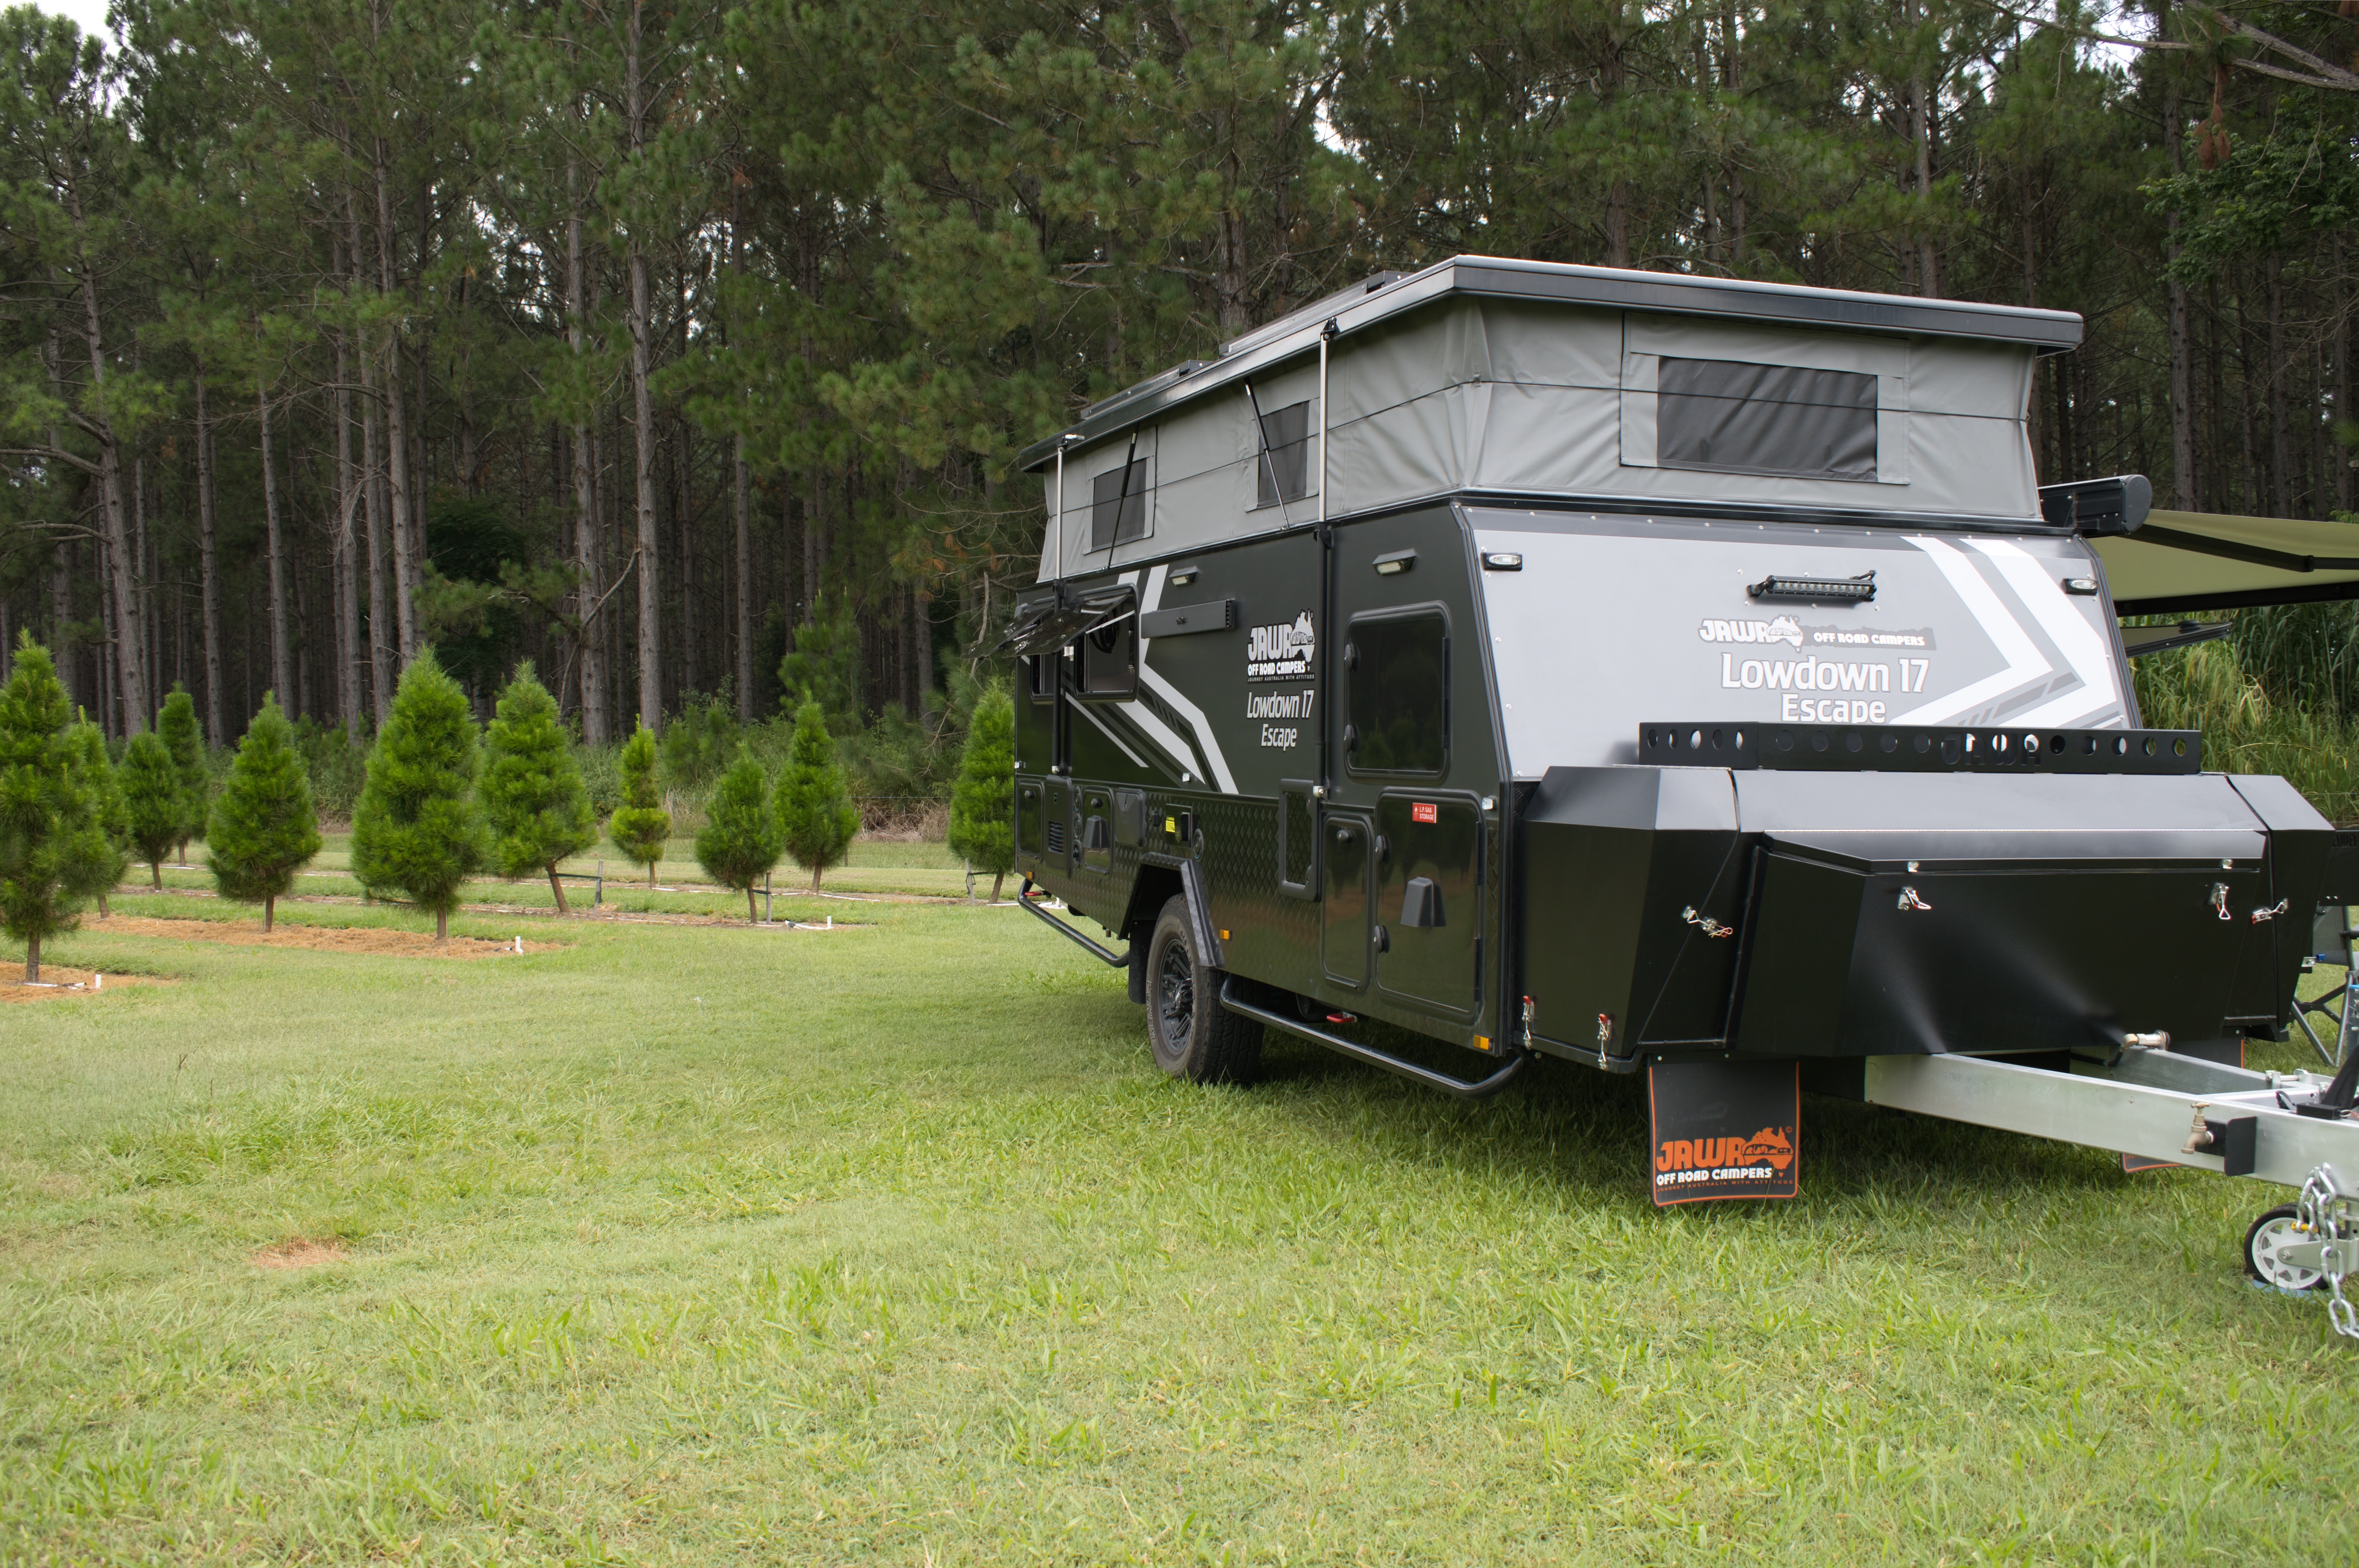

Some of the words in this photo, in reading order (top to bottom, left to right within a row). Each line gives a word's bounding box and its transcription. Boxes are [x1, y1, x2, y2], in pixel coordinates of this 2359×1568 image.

[1248, 624, 1293, 661] JAWA
[1700, 620, 1769, 643] JAWA
[1813, 632, 1835, 642] OFF
[1837, 633, 1869, 644] ROAD
[1871, 634, 1925, 646] CAMPERS
[1248, 663, 1259, 676] OFF
[1259, 662, 1275, 675] ROAD
[1276, 660, 1305, 674] CAMPERS
[1721, 653, 1890, 692] Lowdown
[1899, 658, 1930, 692] 17
[1247, 691, 1300, 719] Lowdown
[1302, 690, 1315, 719] 17
[1781, 693, 1886, 724] Escape
[1261, 723, 1297, 751] Escape
[1941, 732, 2041, 766] JAWA
[1147, 981, 1155, 1039] KENDA
[1656, 1137, 1746, 1171] JAWA
[1656, 1172, 1676, 1186] OFF
[1677, 1170, 1709, 1183] ROAD
[1712, 1167, 1772, 1180] CAMPERS
